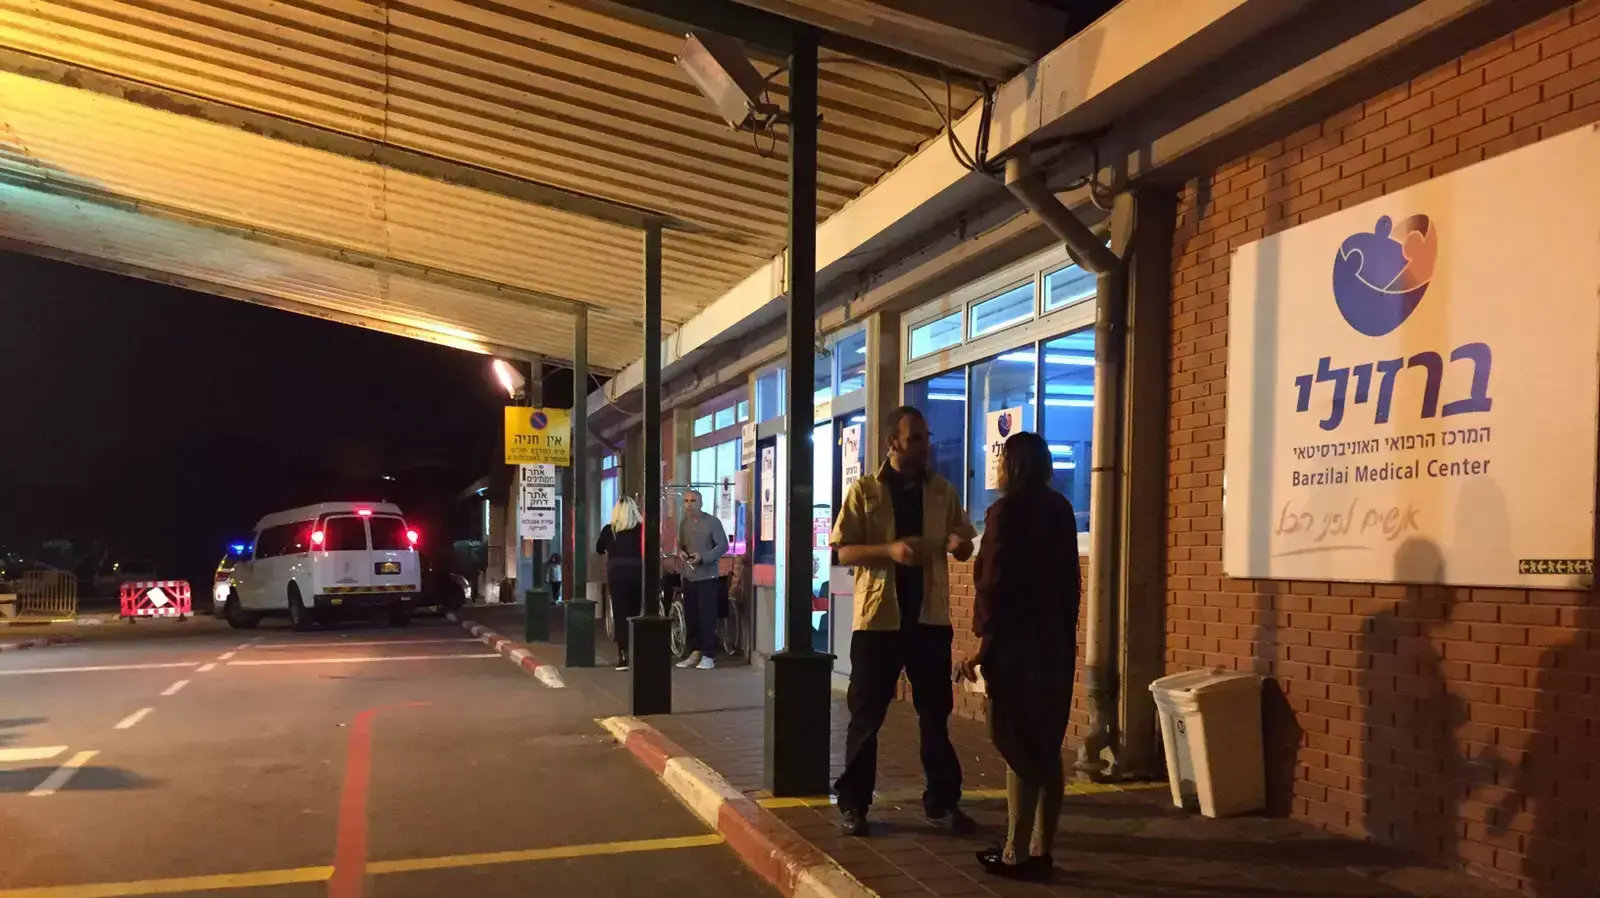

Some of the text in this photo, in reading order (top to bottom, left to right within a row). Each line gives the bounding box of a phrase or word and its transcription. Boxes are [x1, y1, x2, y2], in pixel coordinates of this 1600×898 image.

[1295, 342, 1493, 431] ברזילי
[514, 433, 562, 447] אין חניה
[1293, 427, 1491, 460] המרכז הרפואי האוניברסיטאי
[528, 468, 545, 476] אתר
[1293, 458, 1491, 487] Barzilai Medical Center
[527, 491, 548, 499] אתר
[530, 499, 549, 507] דחק
[1276, 501, 1314, 536] הכל
[1315, 497, 1360, 542] לפני
